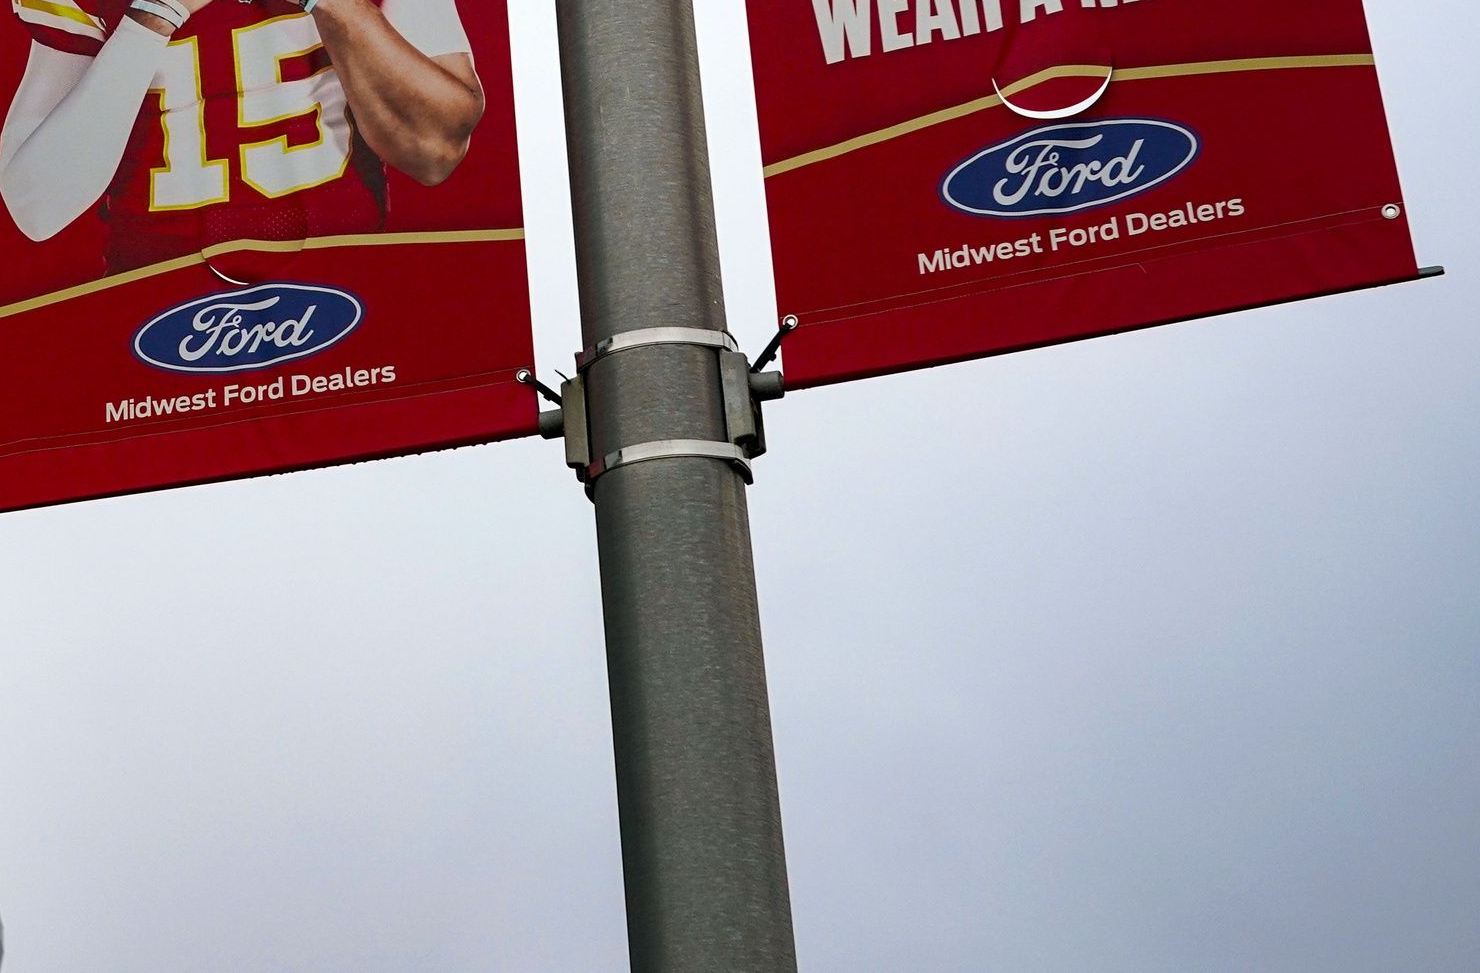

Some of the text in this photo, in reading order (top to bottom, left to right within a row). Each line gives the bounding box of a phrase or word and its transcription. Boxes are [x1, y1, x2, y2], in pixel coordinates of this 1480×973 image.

[146, 12, 353, 211] 15
[992, 134, 1145, 206] Ford
[918, 197, 1246, 275] Midwest Ford Dealers
[178, 296, 318, 361] Ford
[105, 364, 396, 423] Midwest Ford Dealers
